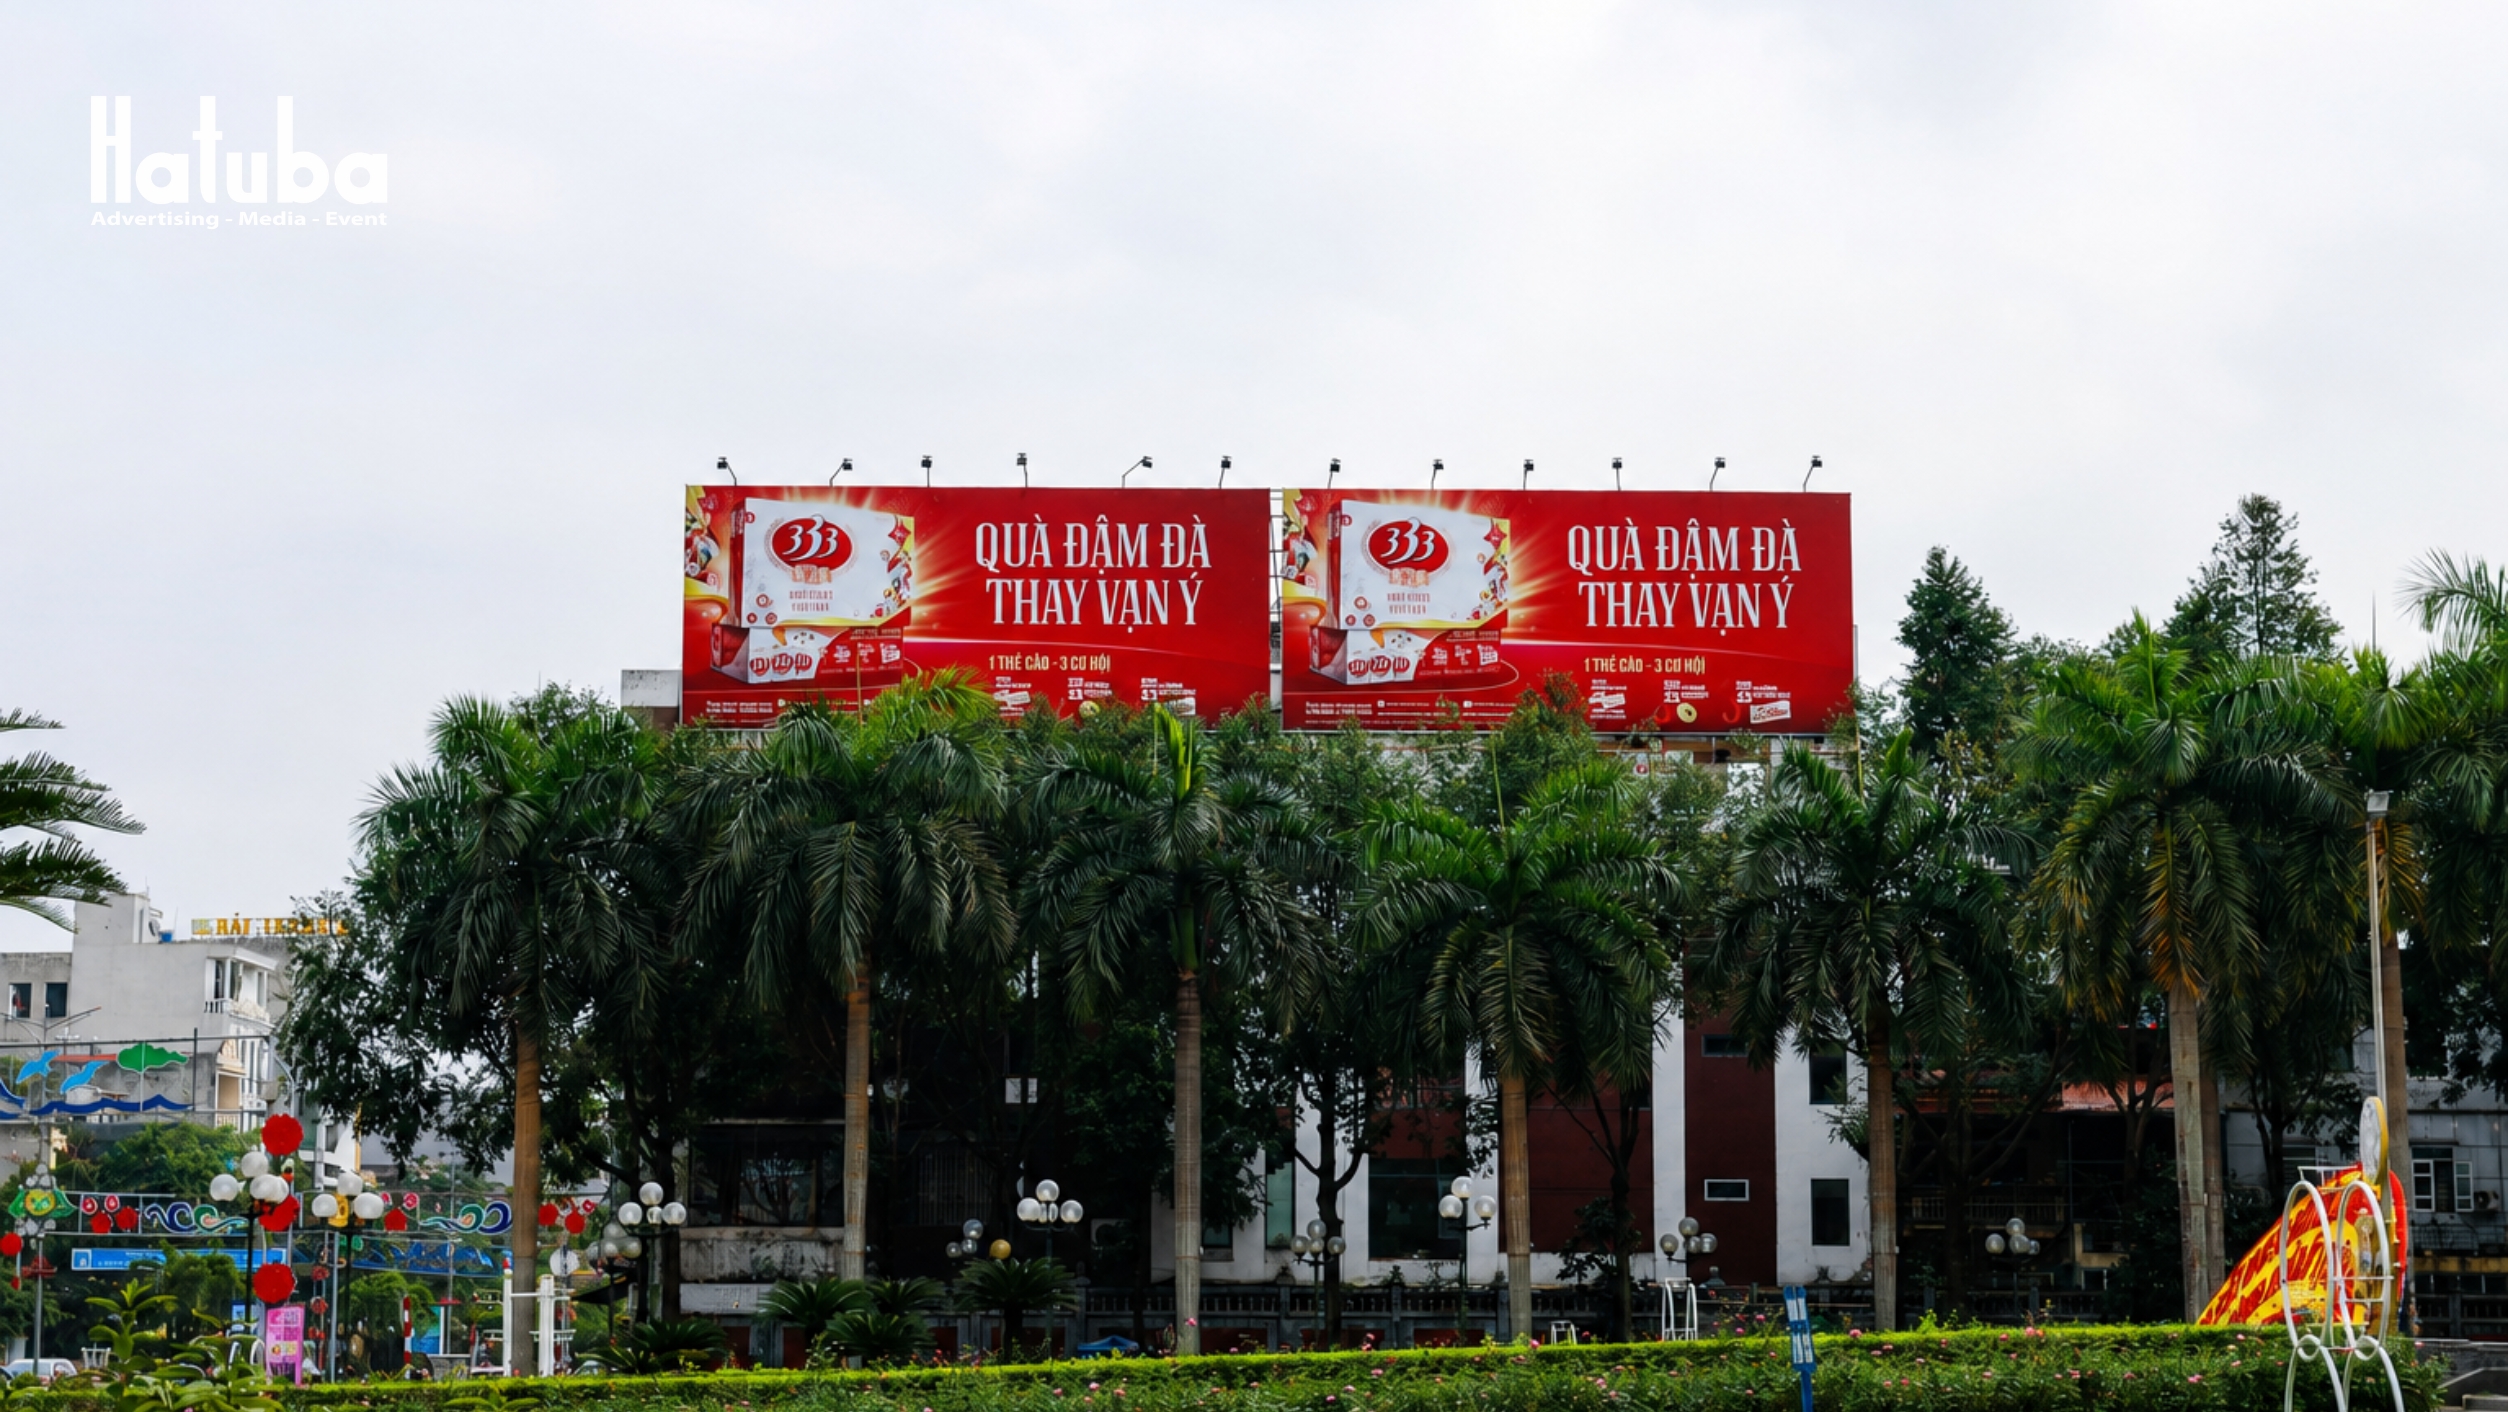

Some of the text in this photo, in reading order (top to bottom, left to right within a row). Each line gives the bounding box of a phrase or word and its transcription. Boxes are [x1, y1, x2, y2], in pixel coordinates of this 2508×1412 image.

[782, 513, 839, 562] 333
[975, 513, 1212, 575] QUÀ ĐẬM ĐÀ
[1380, 516, 1435, 565] 333
[1567, 517, 1802, 580] QUÀ ĐẬM ĐÀ
[985, 572, 1203, 634] THAY VẠN Ý
[1578, 575, 1794, 637] THAY VẠN Ý
[989, 655, 995, 671] 1
[1059, 655, 1068, 671] 3
[1584, 657, 1590, 673] 1
[1654, 657, 1663, 673] 3
